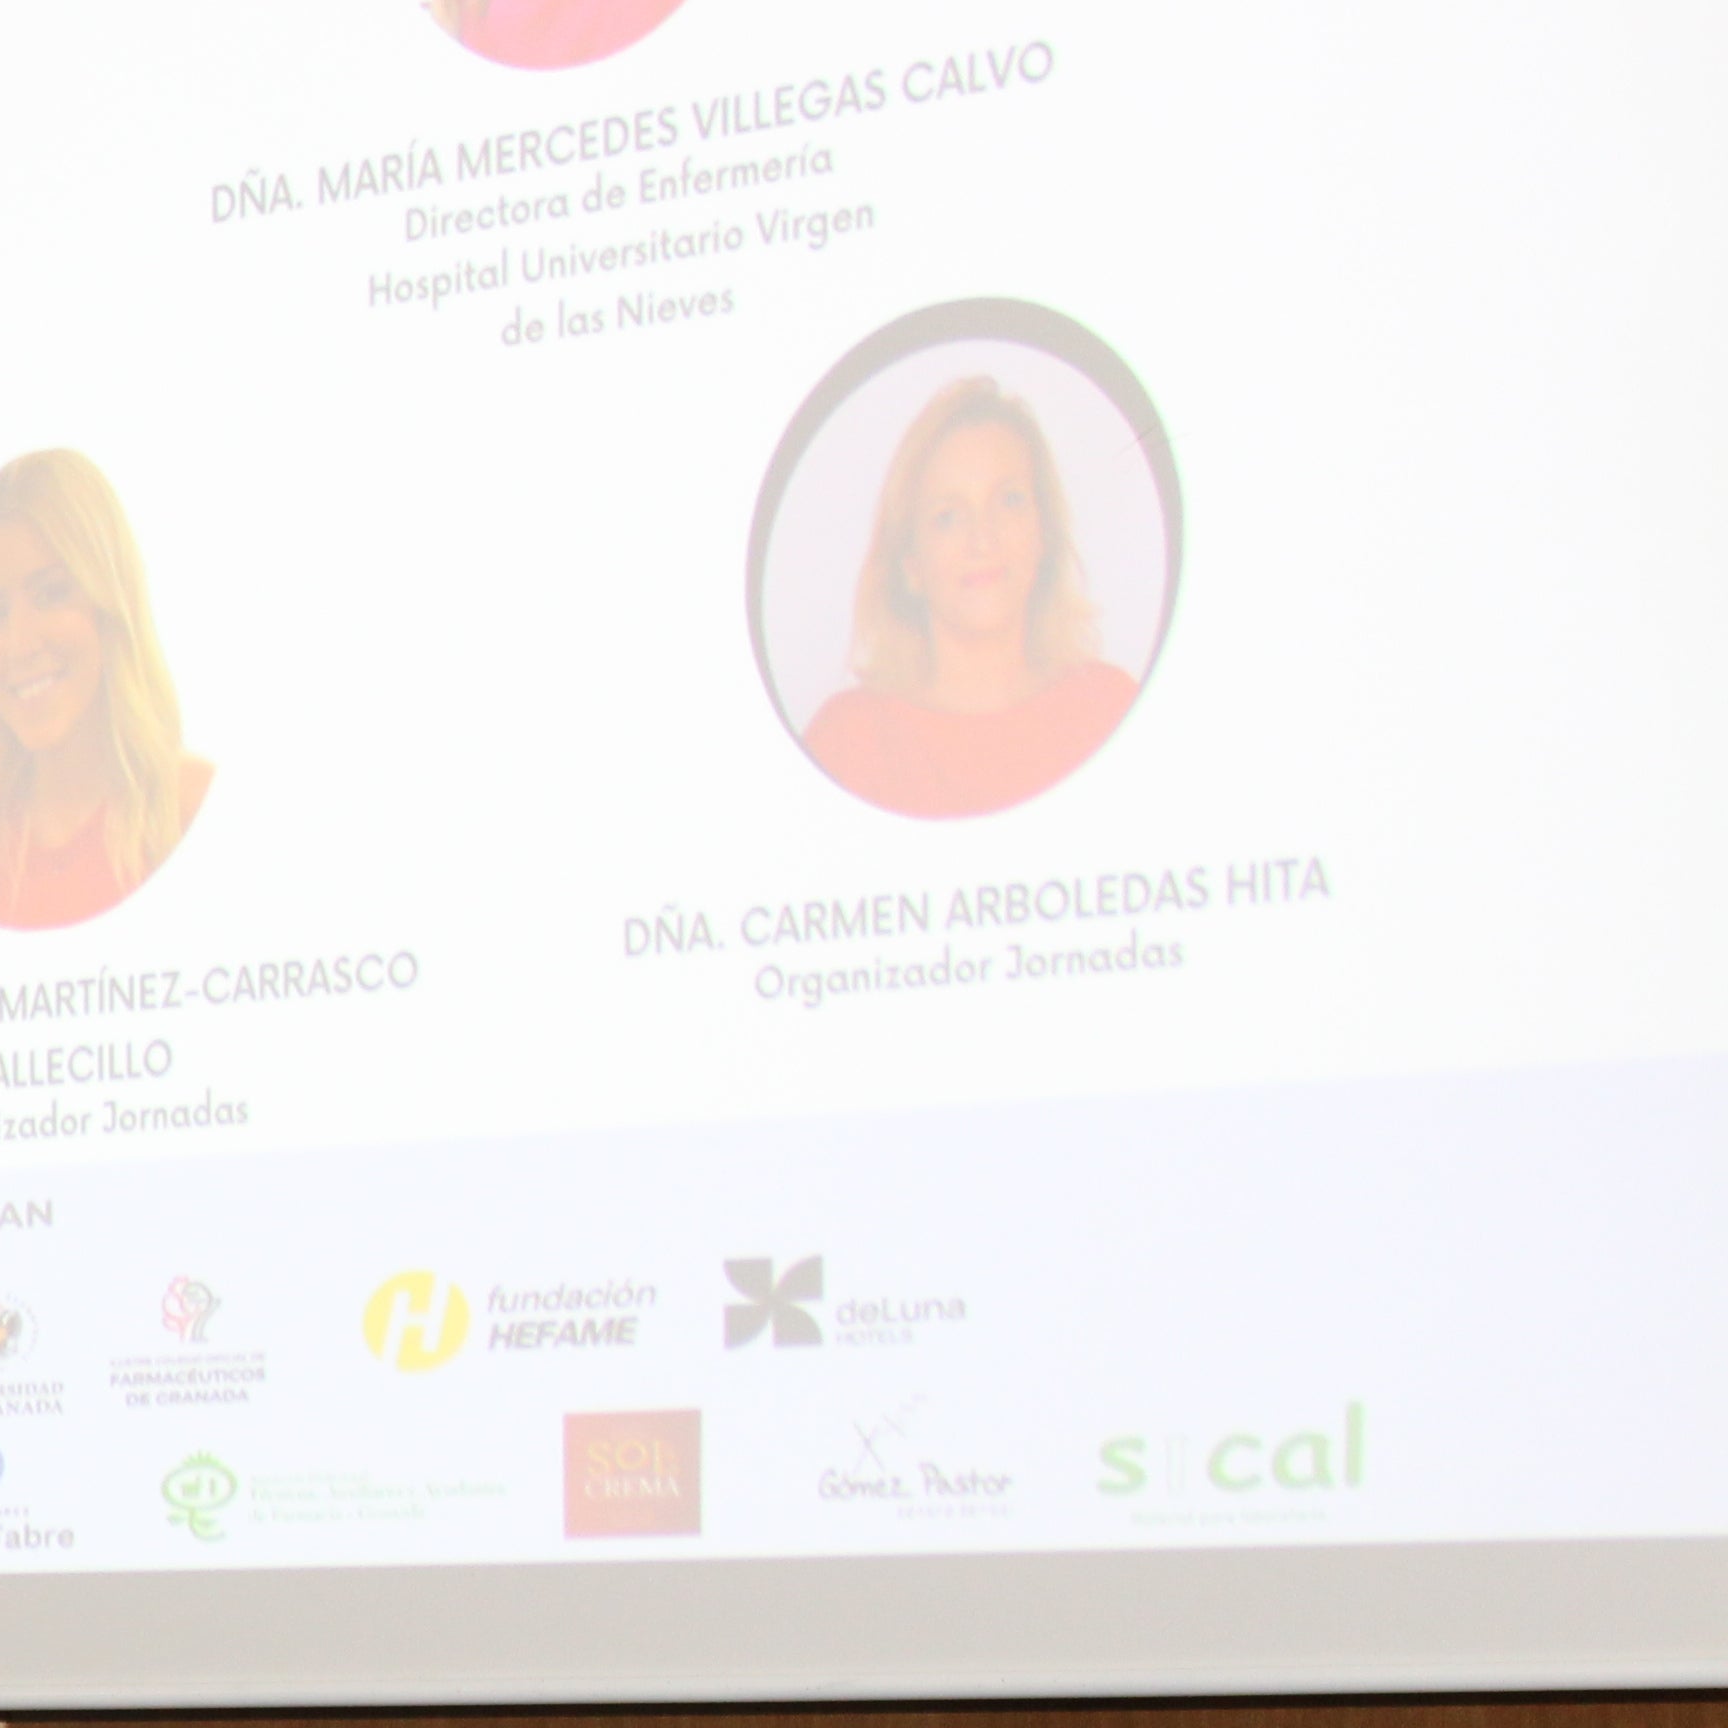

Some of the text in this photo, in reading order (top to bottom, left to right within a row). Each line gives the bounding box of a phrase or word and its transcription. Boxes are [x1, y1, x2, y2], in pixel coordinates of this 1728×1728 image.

[211, 40, 1054, 224] DÑA. MARÍA MERCEDES VILLEGAS CALVO
[404, 143, 833, 243] Directora de Enfermería
[368, 201, 875, 312] Hospital Universitario Virgen
[500, 286, 734, 347] de las Nieves
[624, 856, 1332, 958] DÑA. CARMEN ARBOLEDAS HITA
[753, 928, 1184, 1008] Organizador Jornadas
[102, 1087, 249, 1134] Jornadas
[487, 1280, 657, 1315] fundación
[487, 1315, 639, 1351] HEFAME
[155, 1389, 249, 1406] GRANADA
